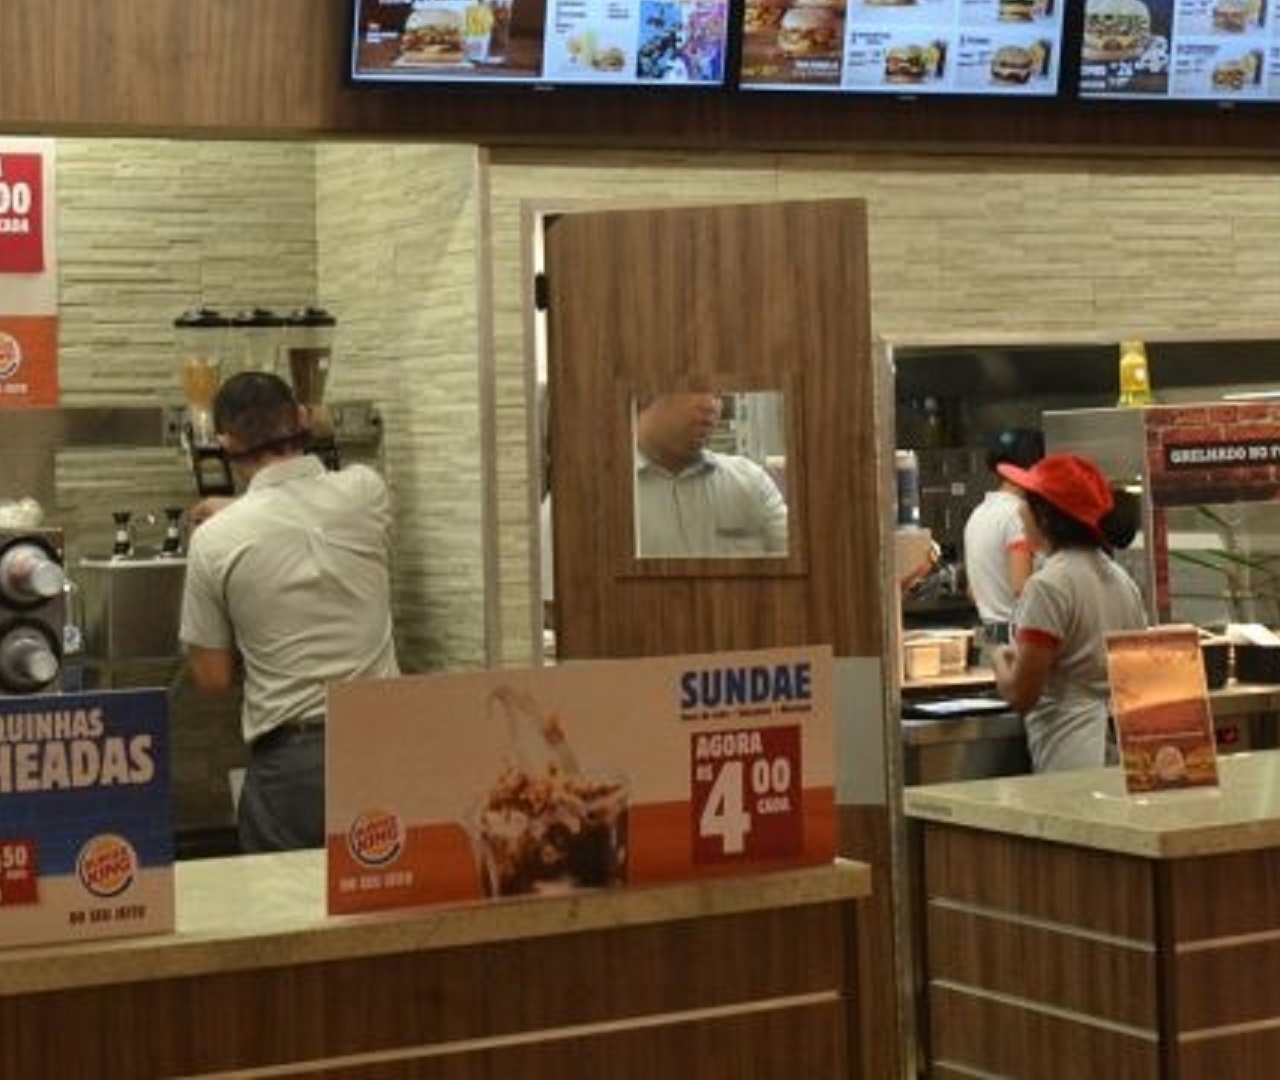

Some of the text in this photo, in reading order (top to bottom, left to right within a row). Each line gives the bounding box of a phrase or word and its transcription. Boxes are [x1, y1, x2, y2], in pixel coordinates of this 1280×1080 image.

[1171, 447, 1246, 464] GRELHADO
[1249, 445, 1267, 460] NO
[681, 662, 812, 709] SUNDAE
[696, 731, 763, 759] AGORA
[699, 761, 751, 855] 4
[757, 796, 791, 814] CADA
[87, 857, 135, 886] KING
